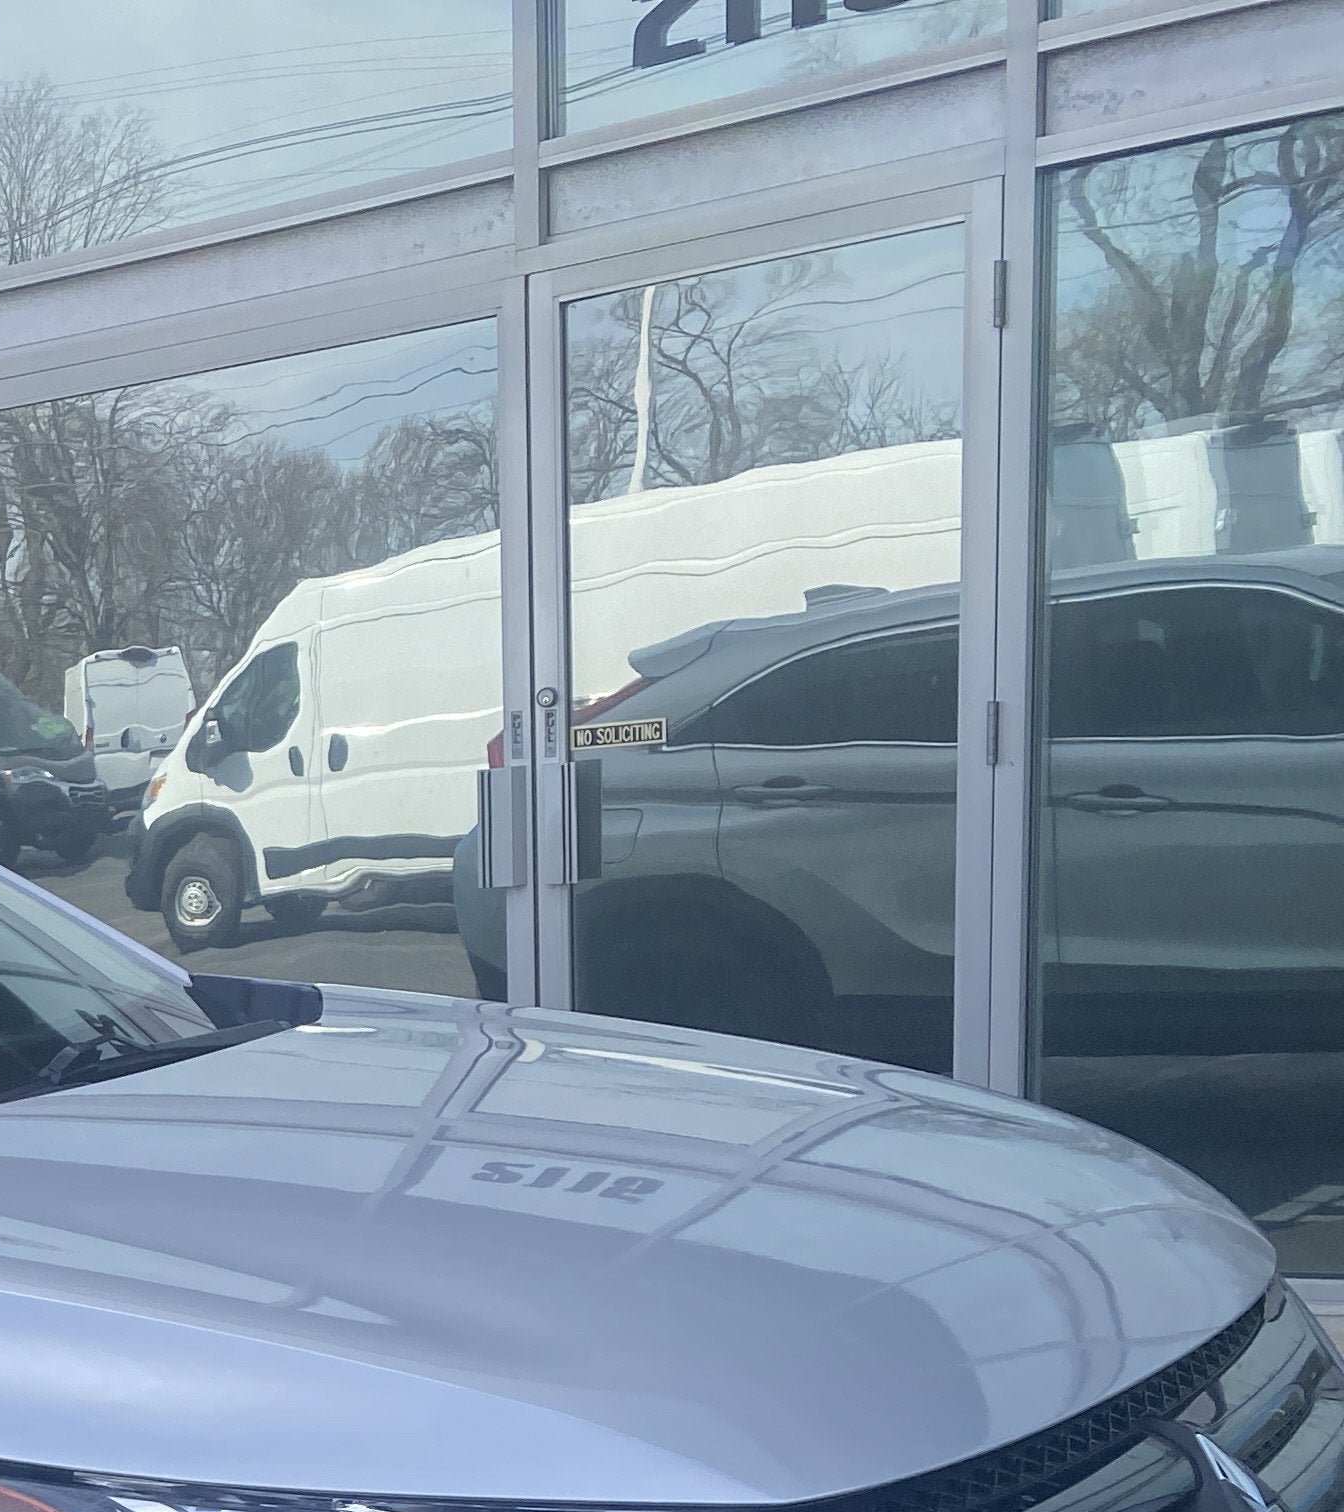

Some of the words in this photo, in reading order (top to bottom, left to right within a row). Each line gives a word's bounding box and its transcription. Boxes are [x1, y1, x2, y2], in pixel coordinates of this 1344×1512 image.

[512, 714, 521, 744] PULL
[546, 712, 555, 743] PULL
[576, 729, 592, 747] NO
[596, 722, 661, 744] SOLICITING
